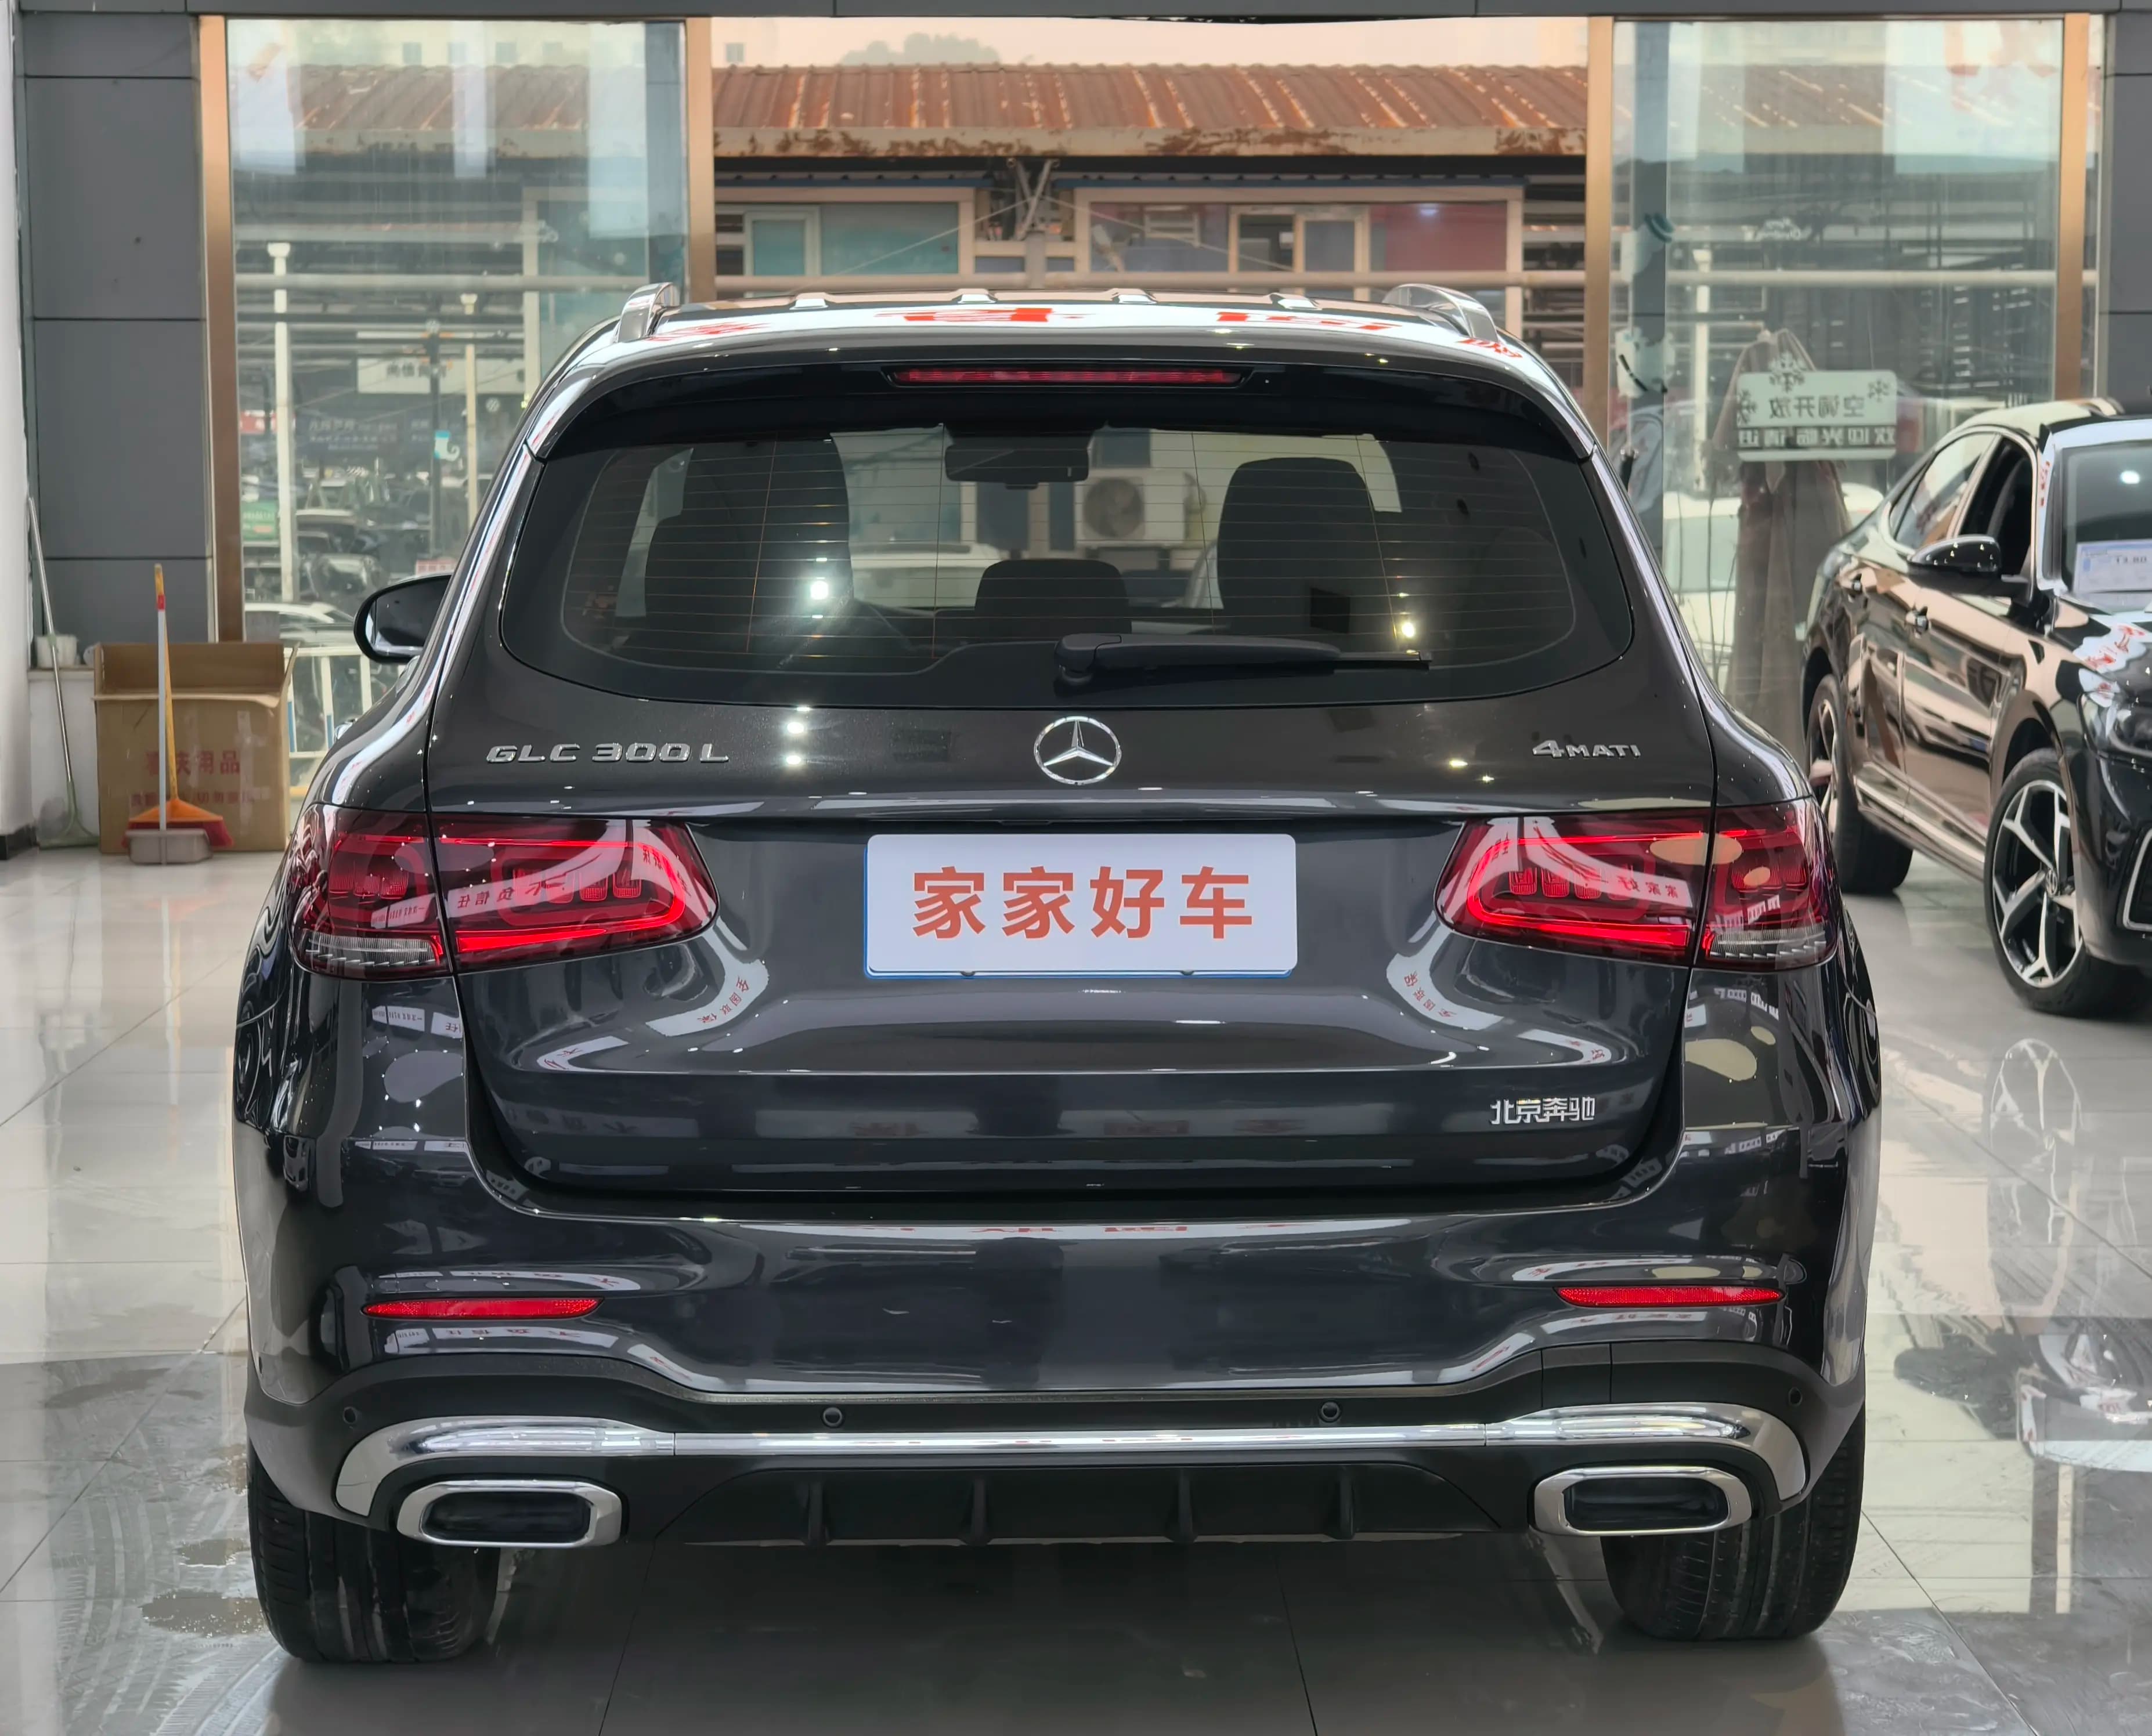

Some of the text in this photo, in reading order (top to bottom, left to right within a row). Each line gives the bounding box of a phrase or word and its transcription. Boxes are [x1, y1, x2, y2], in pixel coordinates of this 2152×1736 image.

[486, 743, 730, 763] GLC 300 L
[1532, 740, 1641, 757] 4MATI
[912, 865, 1252, 939] 家家好车
[1489, 1096, 1595, 1124] 北京奔驰
